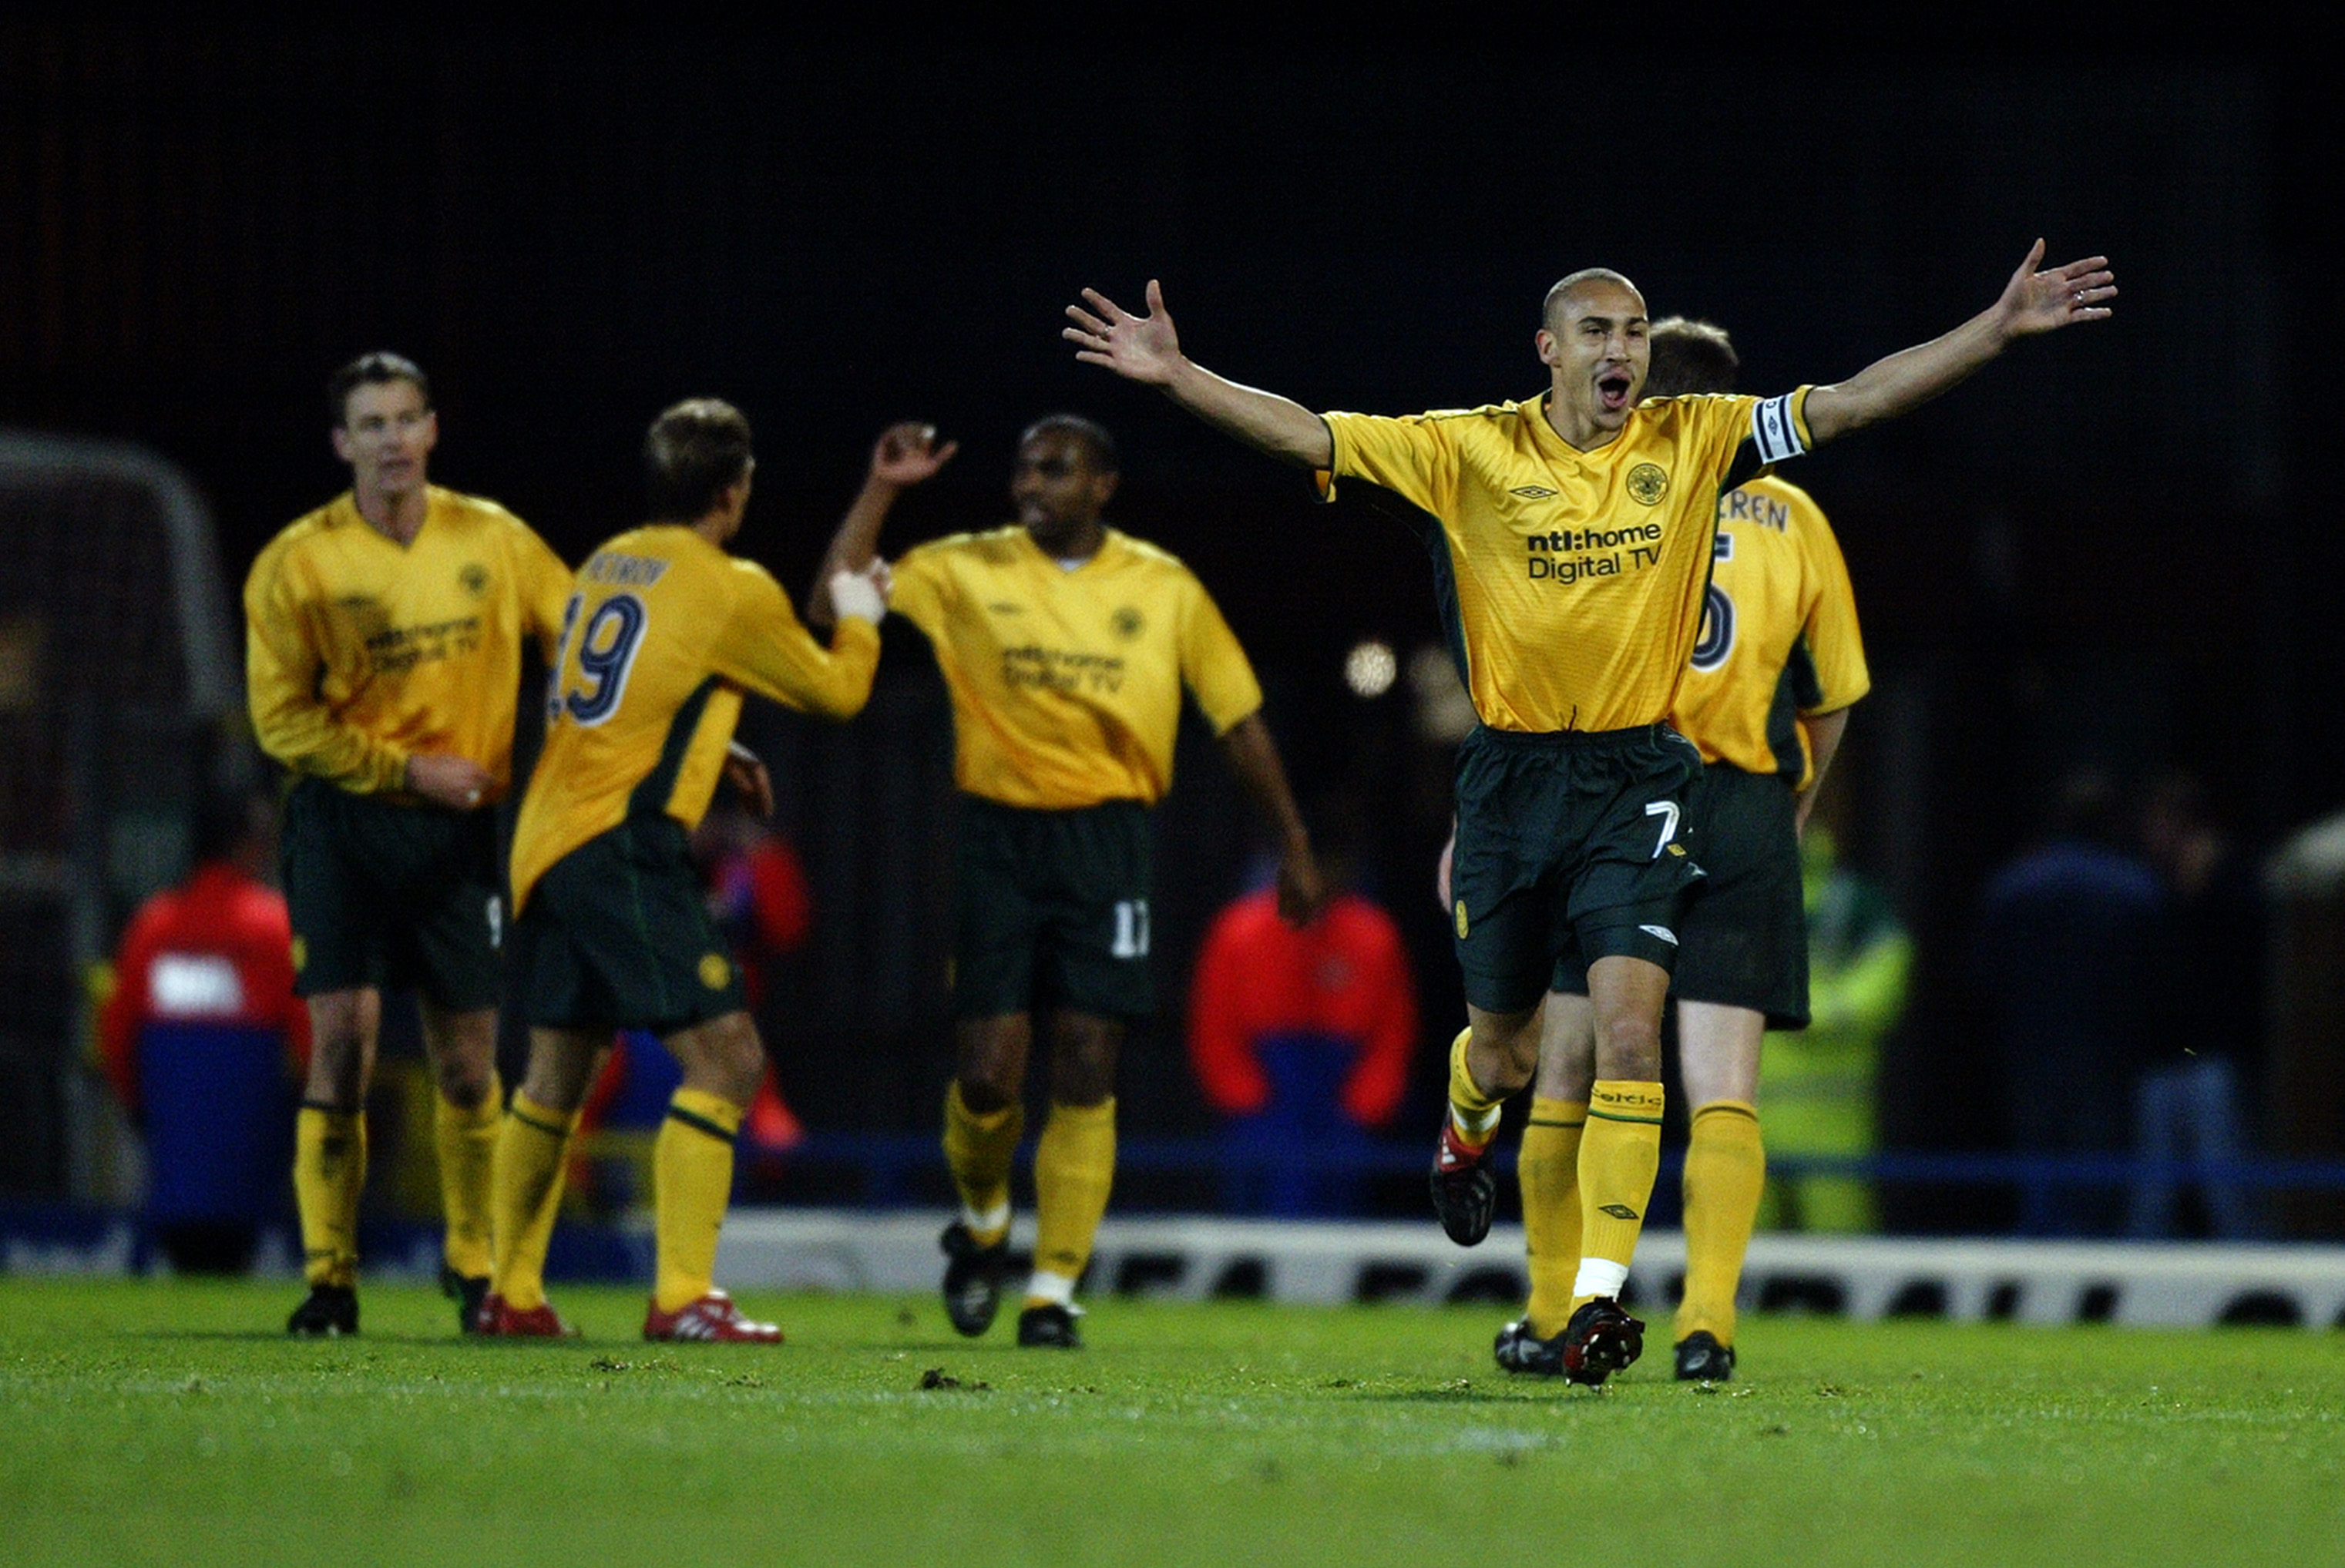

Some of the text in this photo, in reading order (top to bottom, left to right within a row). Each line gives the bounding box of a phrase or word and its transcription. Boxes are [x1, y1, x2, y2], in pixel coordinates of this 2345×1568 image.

[1527, 523, 1662, 552] ntl:home
[1529, 543, 1662, 586] Digital TV
[1645, 801, 1680, 858] 7
